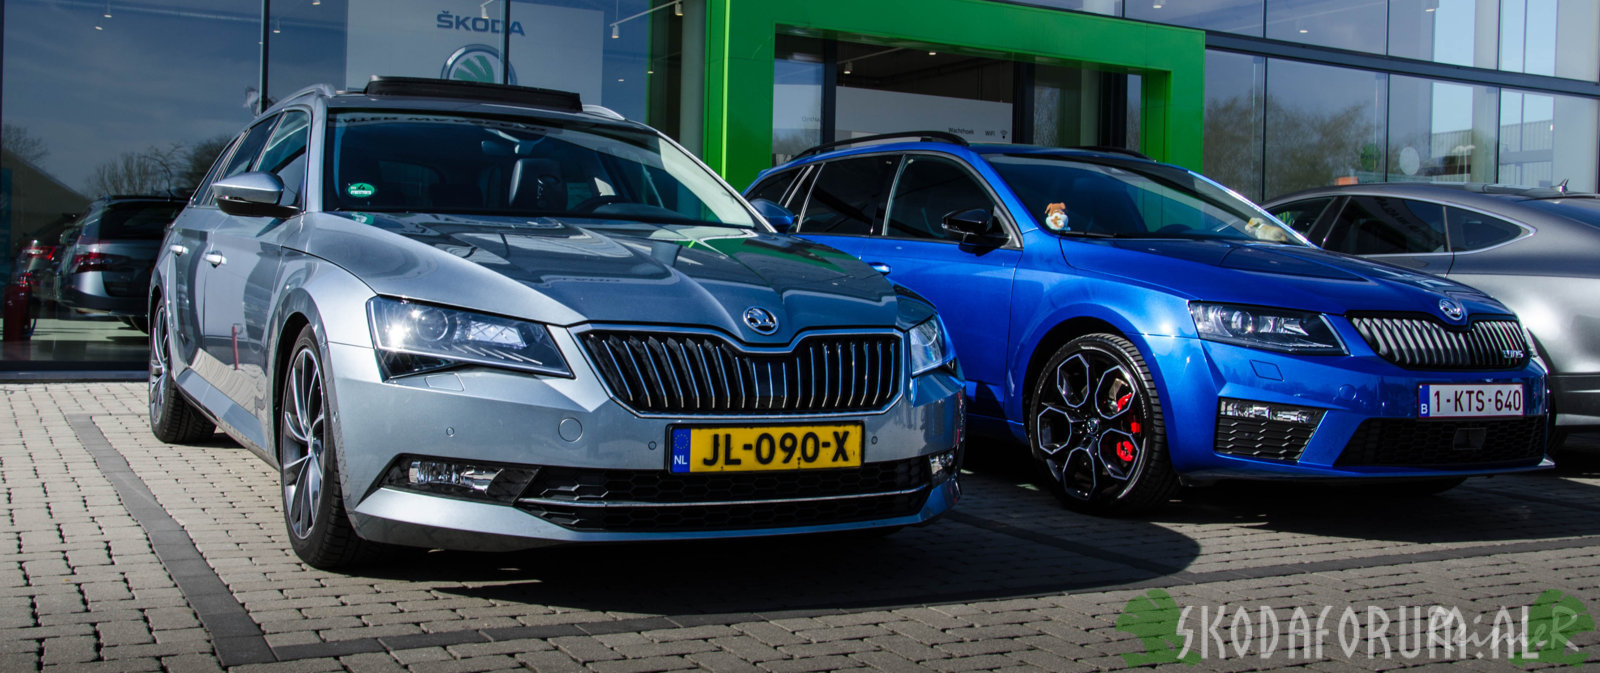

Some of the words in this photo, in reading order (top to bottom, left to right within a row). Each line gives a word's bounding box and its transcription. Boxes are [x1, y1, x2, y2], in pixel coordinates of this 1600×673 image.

[436, 10, 525, 36] ŠKODA
[1420, 403, 1428, 415] B
[1433, 389, 1522, 413] 1-KTS-640
[673, 455, 688, 465] NL
[703, 430, 850, 467] JL-090-X
